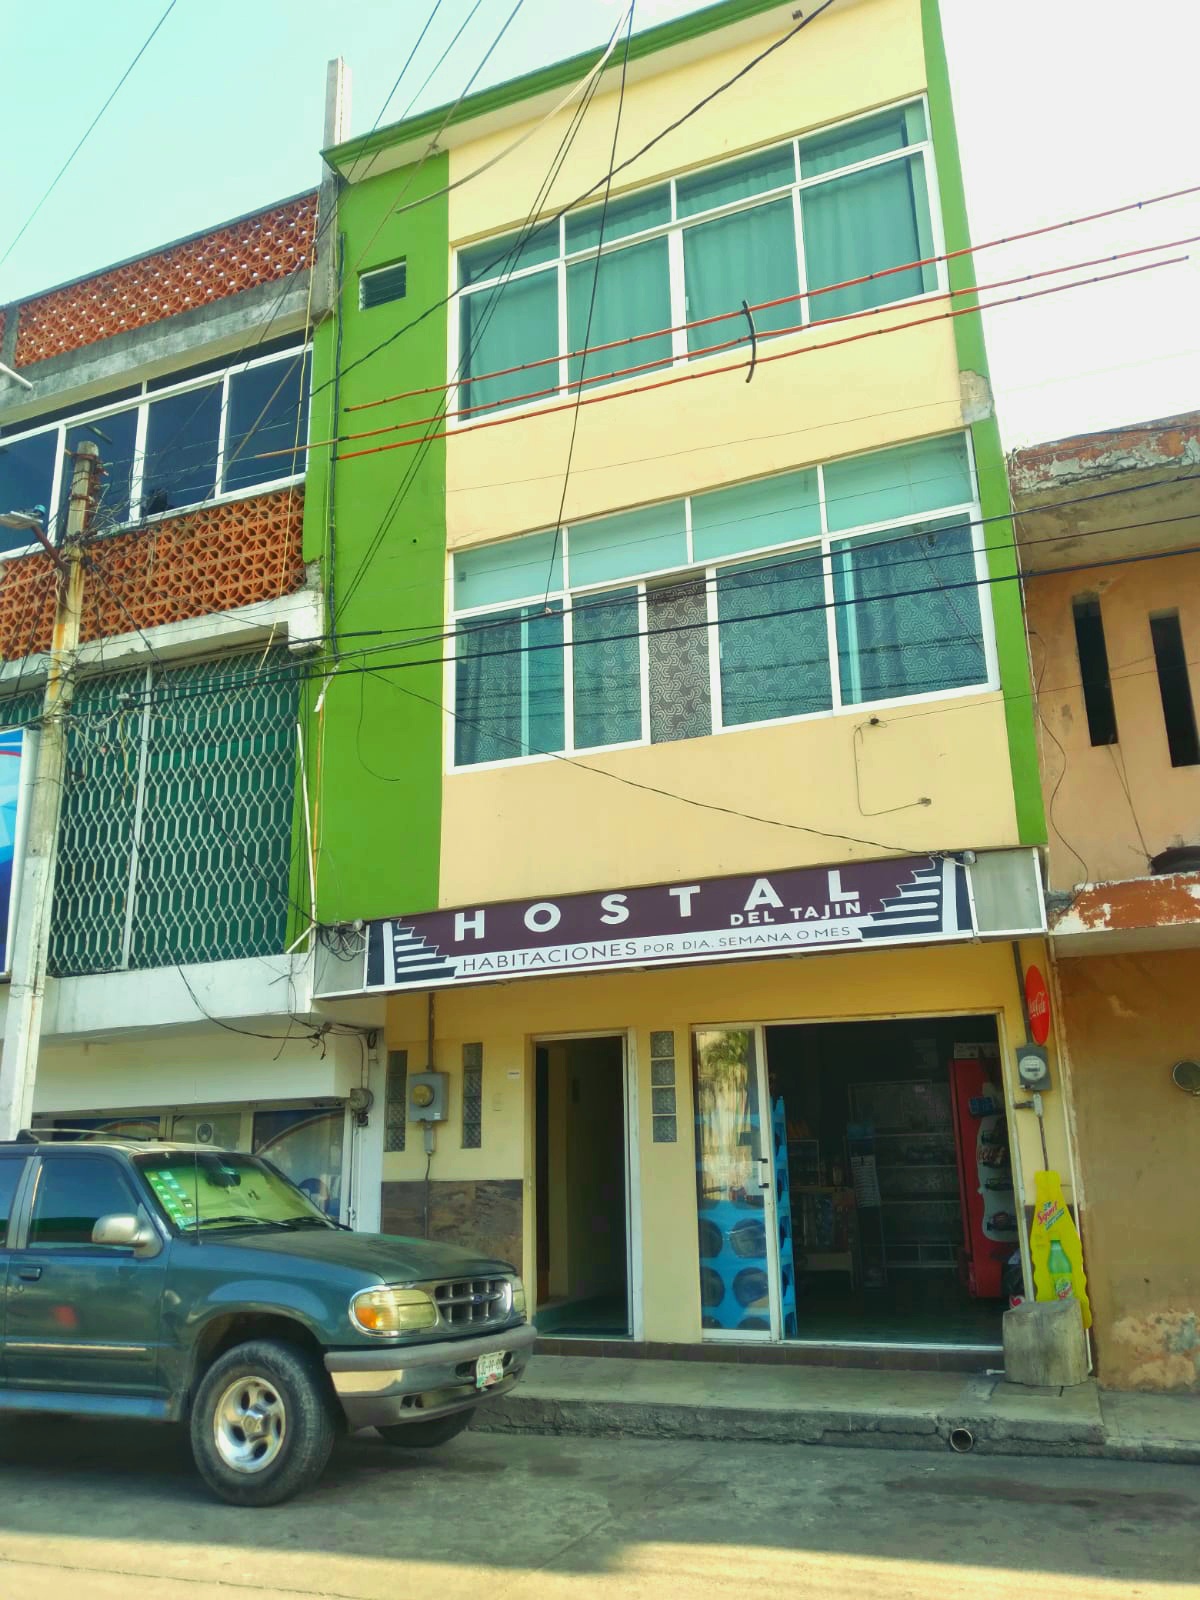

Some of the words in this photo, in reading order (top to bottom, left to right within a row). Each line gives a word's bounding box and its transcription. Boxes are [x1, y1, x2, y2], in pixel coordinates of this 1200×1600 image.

[454, 870, 858, 942] HOSTAL
[730, 911, 776, 926] DEL
[789, 901, 862, 920] TAJIN
[463, 941, 637, 972] HABITACIONES
[643, 942, 675, 953] POR
[718, 930, 792, 946] SEMANA
[796, 930, 810, 940] O
[814, 926, 851, 939] MES
